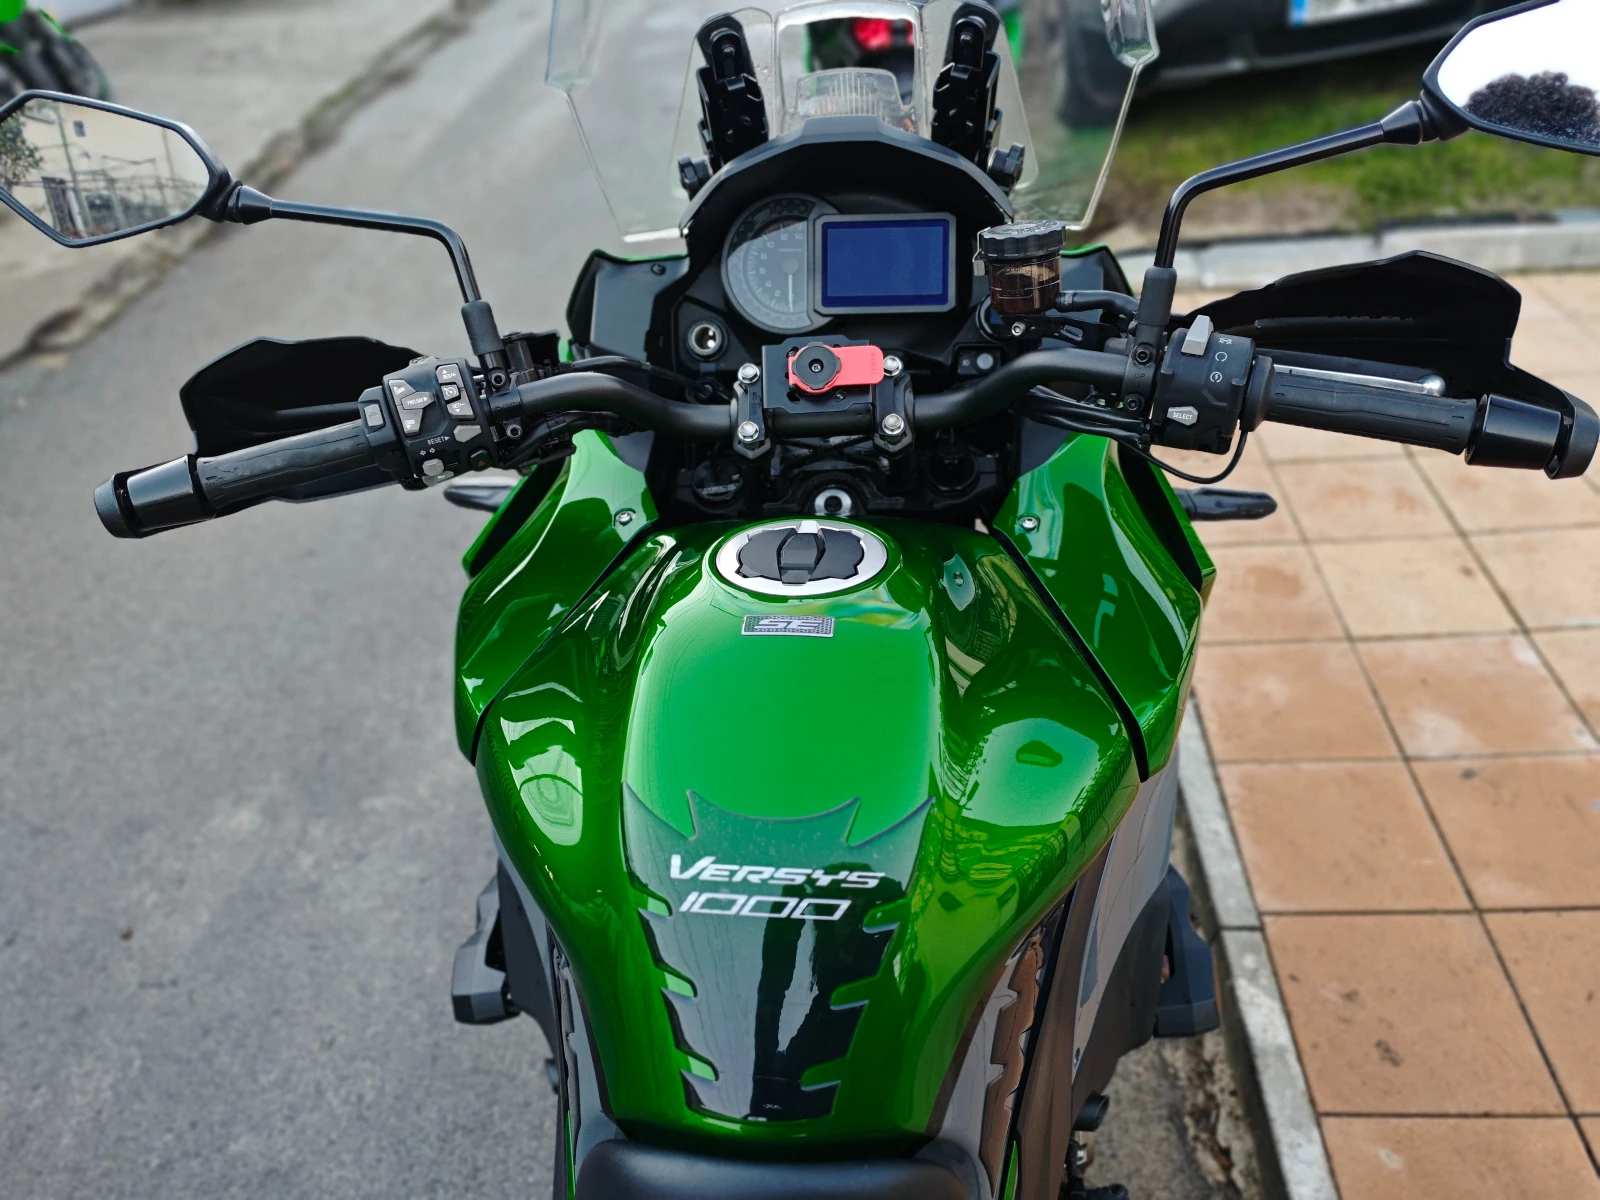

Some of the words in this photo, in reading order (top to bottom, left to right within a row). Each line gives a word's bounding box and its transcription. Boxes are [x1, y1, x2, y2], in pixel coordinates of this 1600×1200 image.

[759, 267, 766, 275] 6
[774, 289, 781, 297] 2
[1172, 411, 1193, 420] SELECT
[427, 436, 445, 446] RESET
[754, 619, 823, 630] SE
[670, 854, 886, 889] VERSYS
[679, 891, 852, 921] 1000
